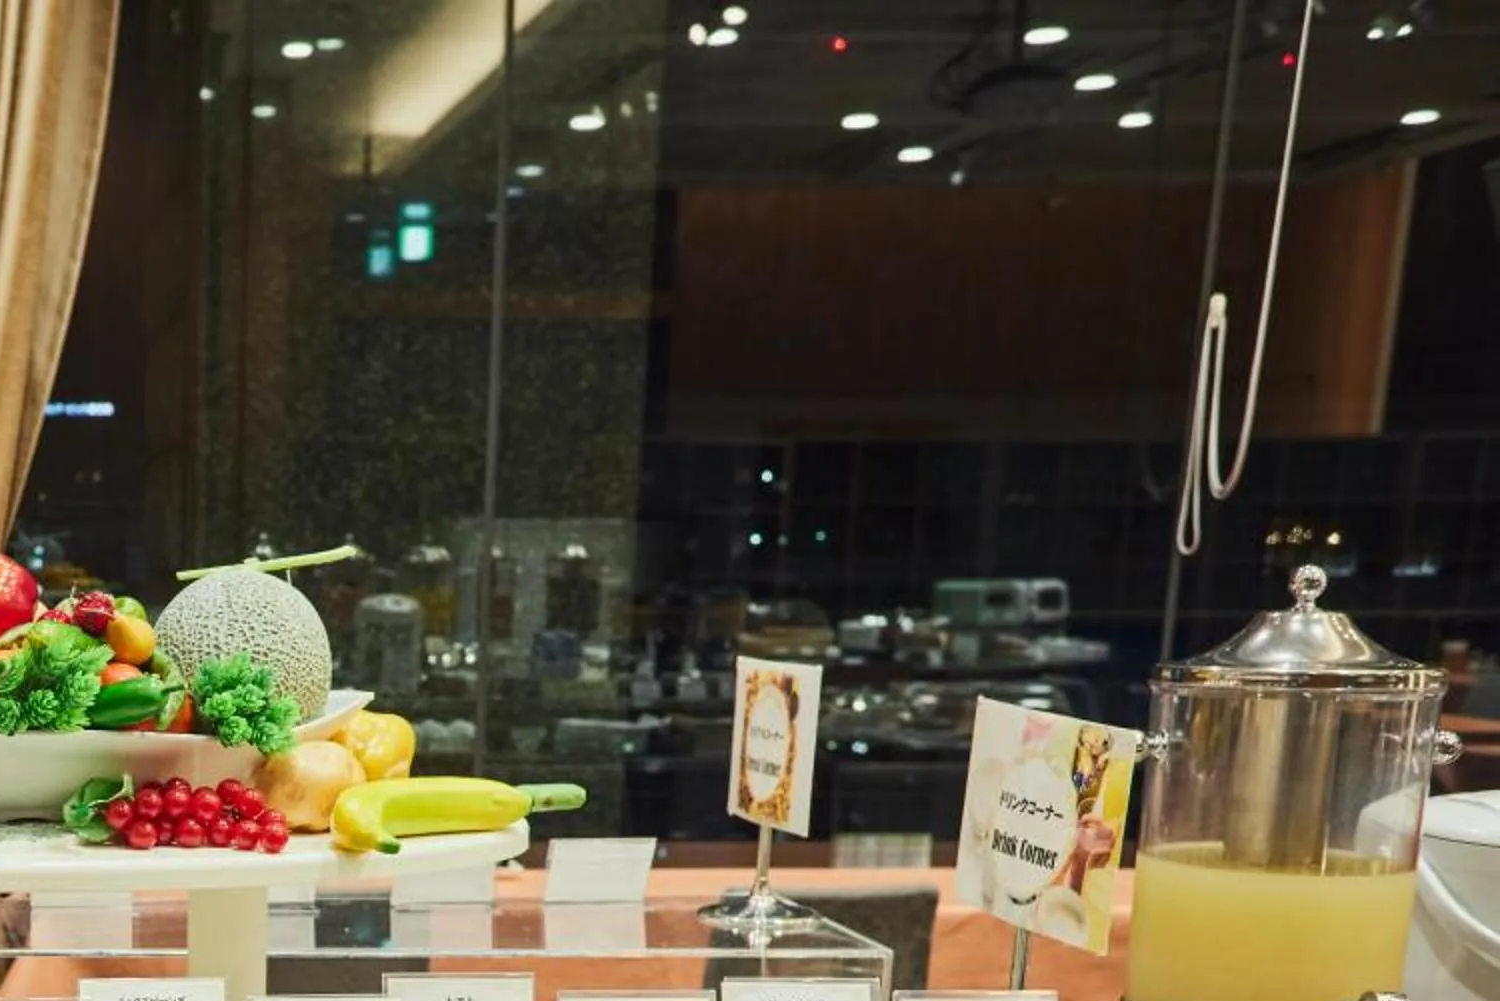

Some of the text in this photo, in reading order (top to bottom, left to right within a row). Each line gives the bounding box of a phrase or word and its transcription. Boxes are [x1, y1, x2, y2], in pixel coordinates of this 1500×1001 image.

[999, 789, 1064, 820] ドリンクコーナー
[991, 828, 1059, 870] Drink Corner
